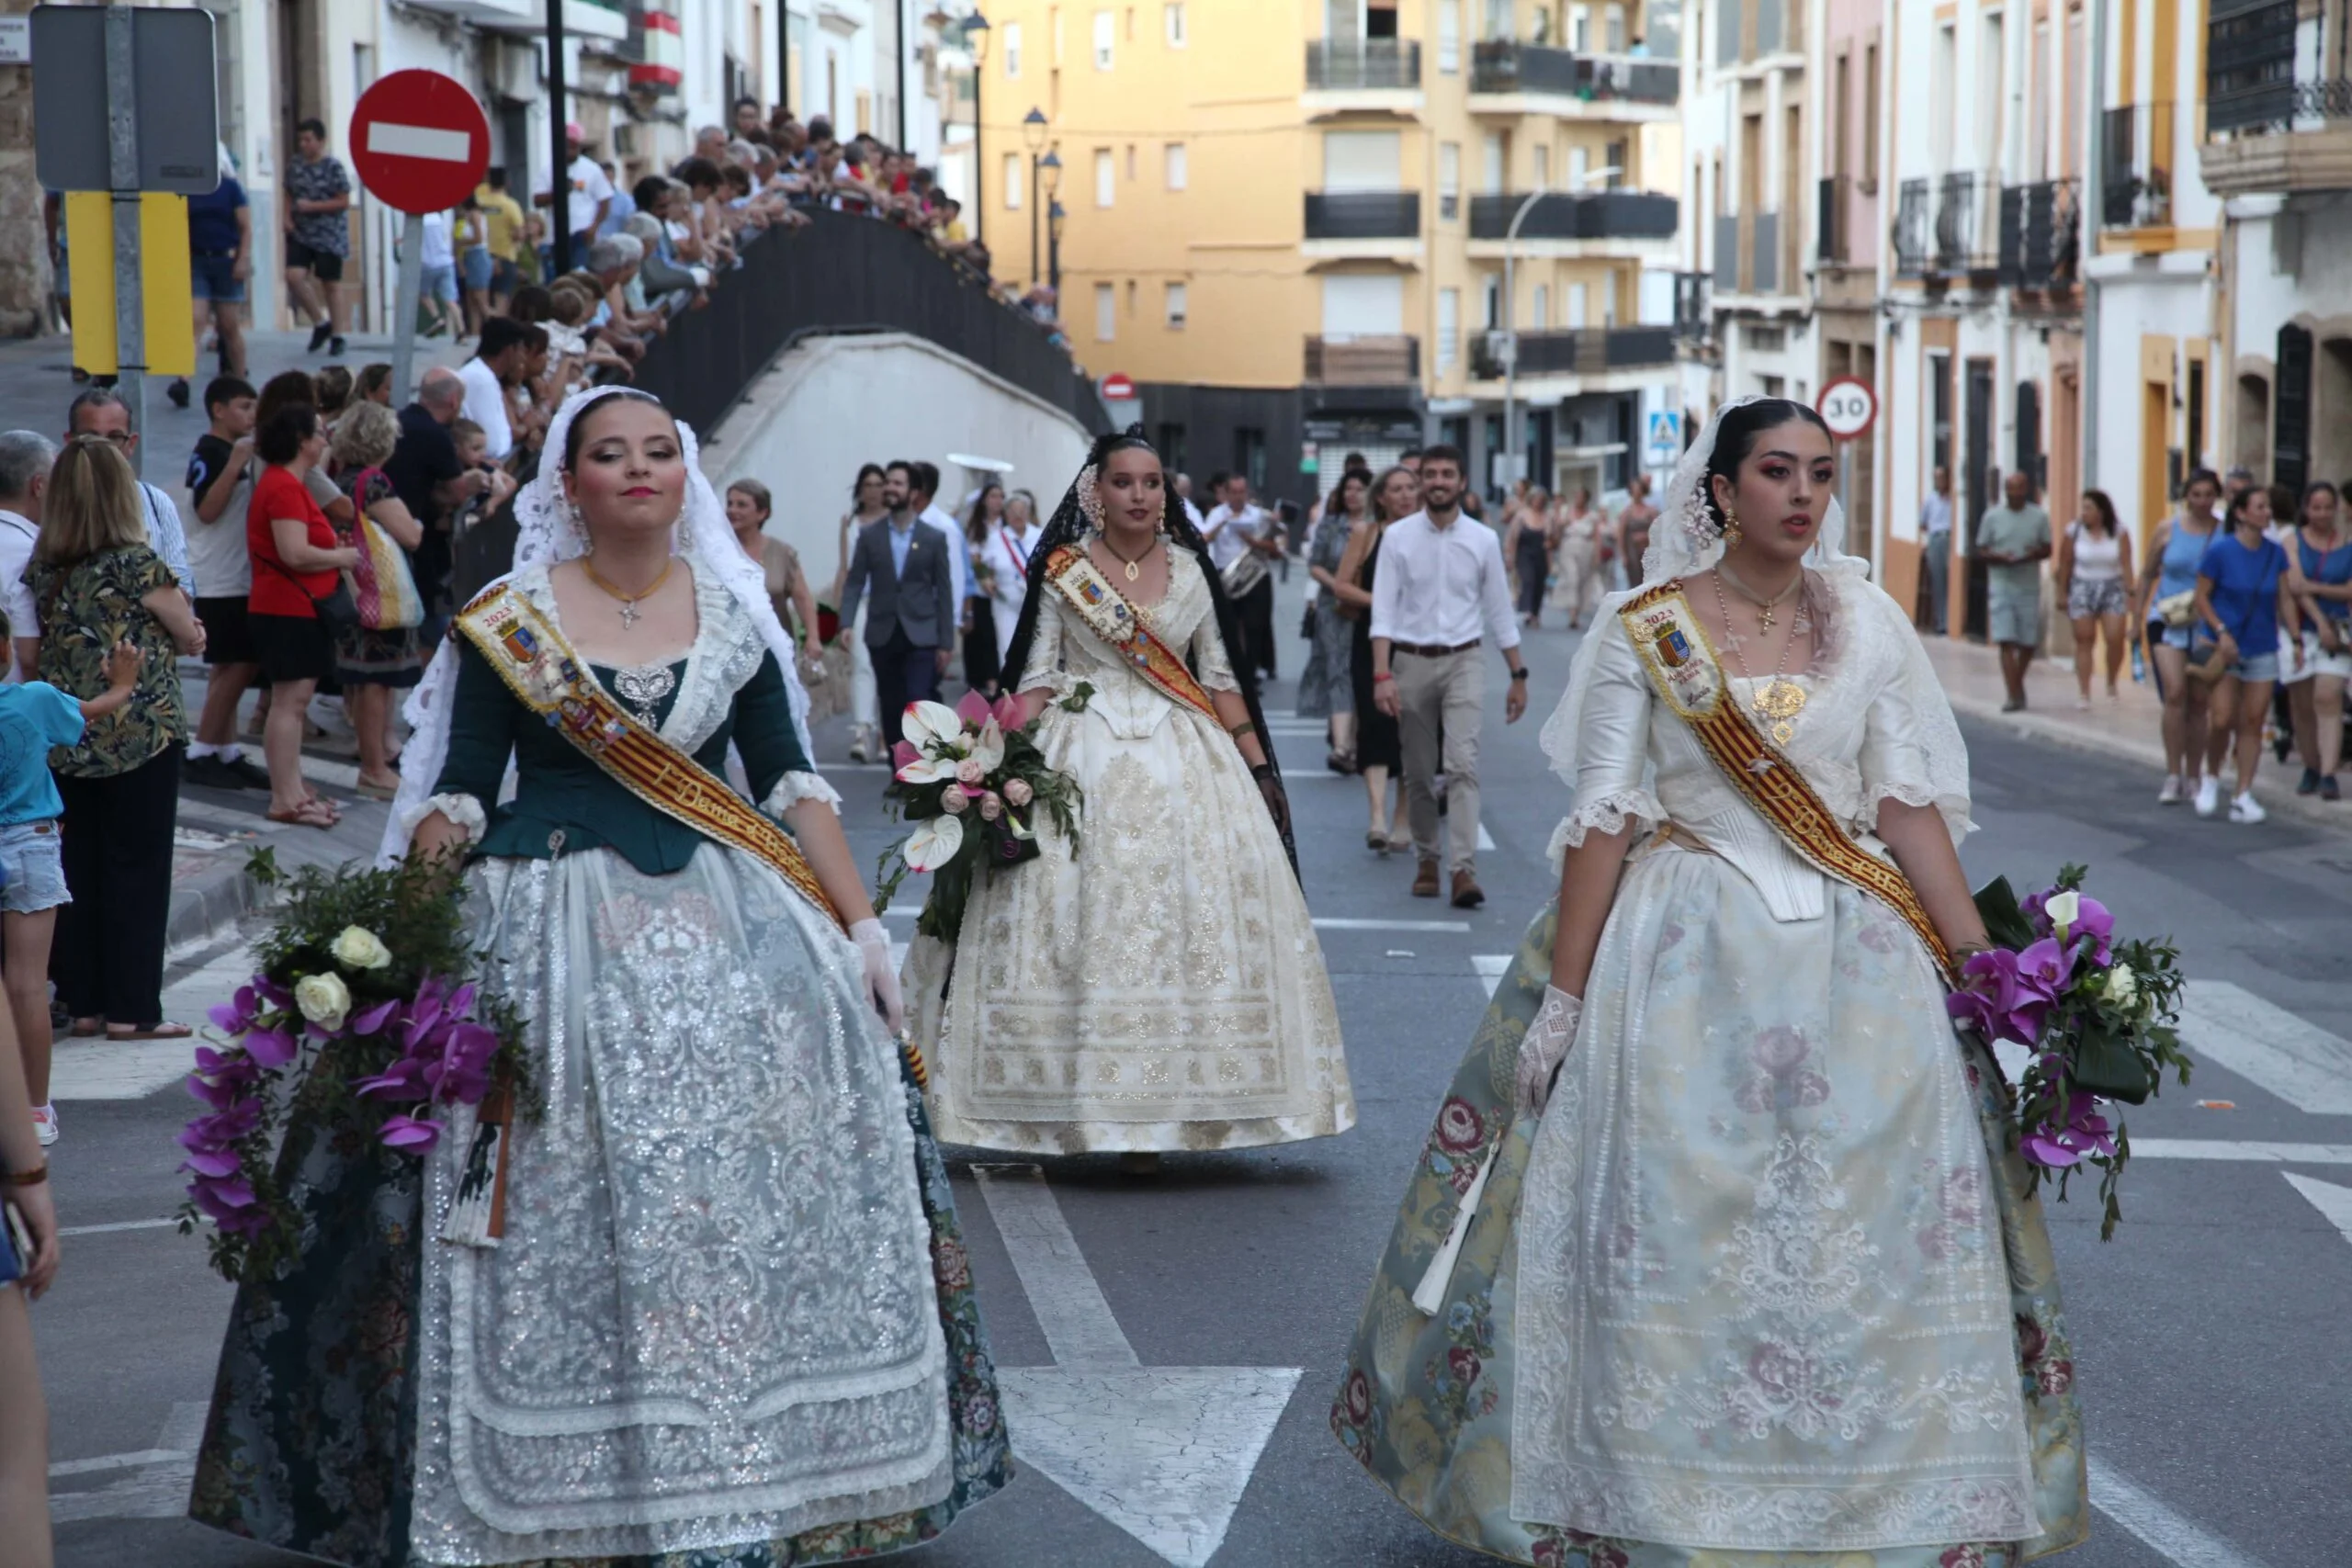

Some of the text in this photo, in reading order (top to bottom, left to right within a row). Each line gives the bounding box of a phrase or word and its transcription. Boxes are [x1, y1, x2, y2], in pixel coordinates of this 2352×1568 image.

[1828, 397, 1865, 419] 30
[482, 606, 513, 627] 2023
[1645, 609, 1675, 626] 2023
[674, 776, 740, 826] Dama
[1790, 805, 1844, 862] Dama
